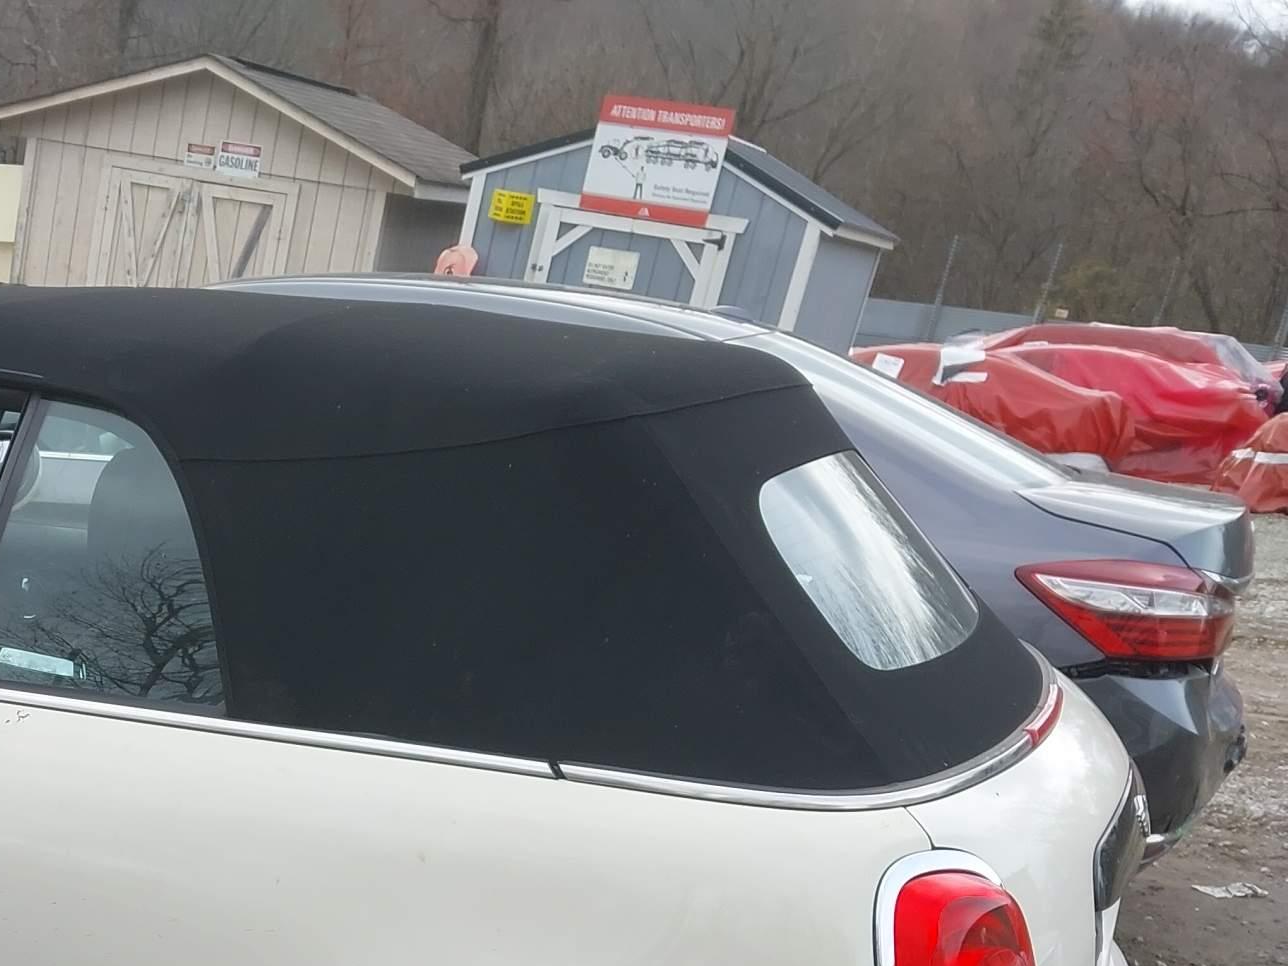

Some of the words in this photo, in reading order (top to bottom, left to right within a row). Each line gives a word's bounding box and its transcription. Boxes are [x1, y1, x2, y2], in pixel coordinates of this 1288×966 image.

[610, 104, 656, 121] ATTENTION
[657, 110, 726, 130] TRANSPORTERS!
[218, 154, 258, 172] GASOLINE
